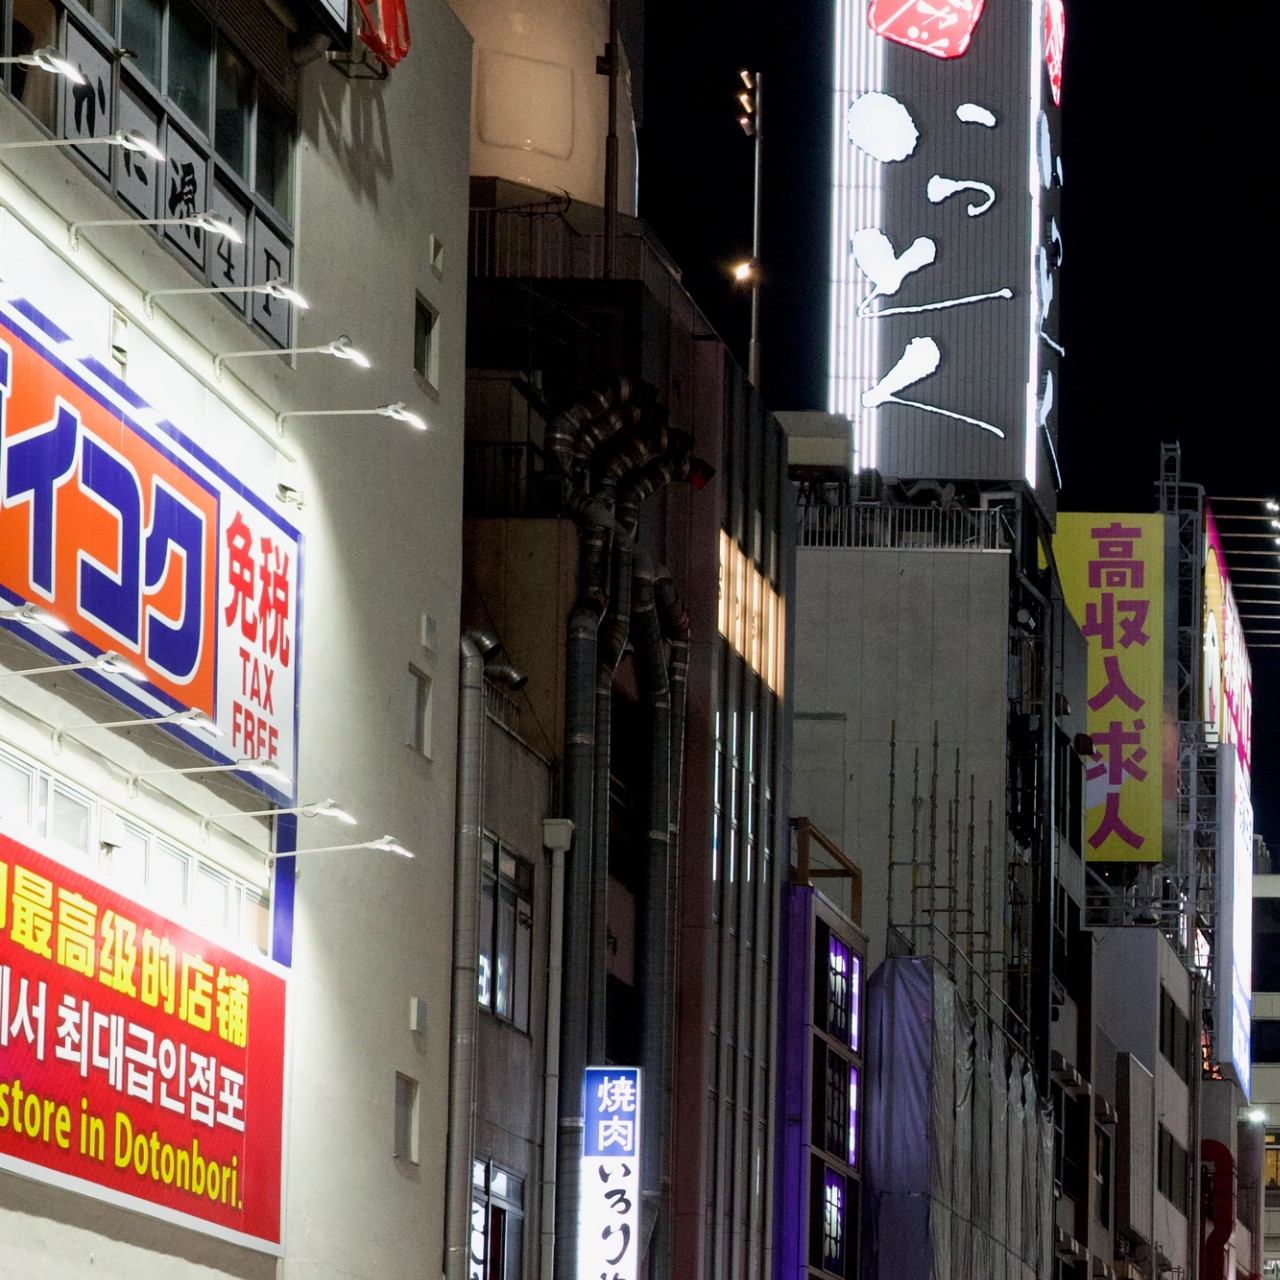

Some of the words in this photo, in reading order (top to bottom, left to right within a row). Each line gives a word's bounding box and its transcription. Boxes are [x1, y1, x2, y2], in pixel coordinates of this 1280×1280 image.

[225, 510, 290, 668] 免税
[239, 646, 275, 715] TAX
[1082, 522, 1150, 850] 高収入求人
[0, 965, 47, 1060] 서
[80, 1098, 104, 1161] in
[114, 1111, 243, 1210] Dotonbori.
[597, 1075, 636, 1151] 焼肉
